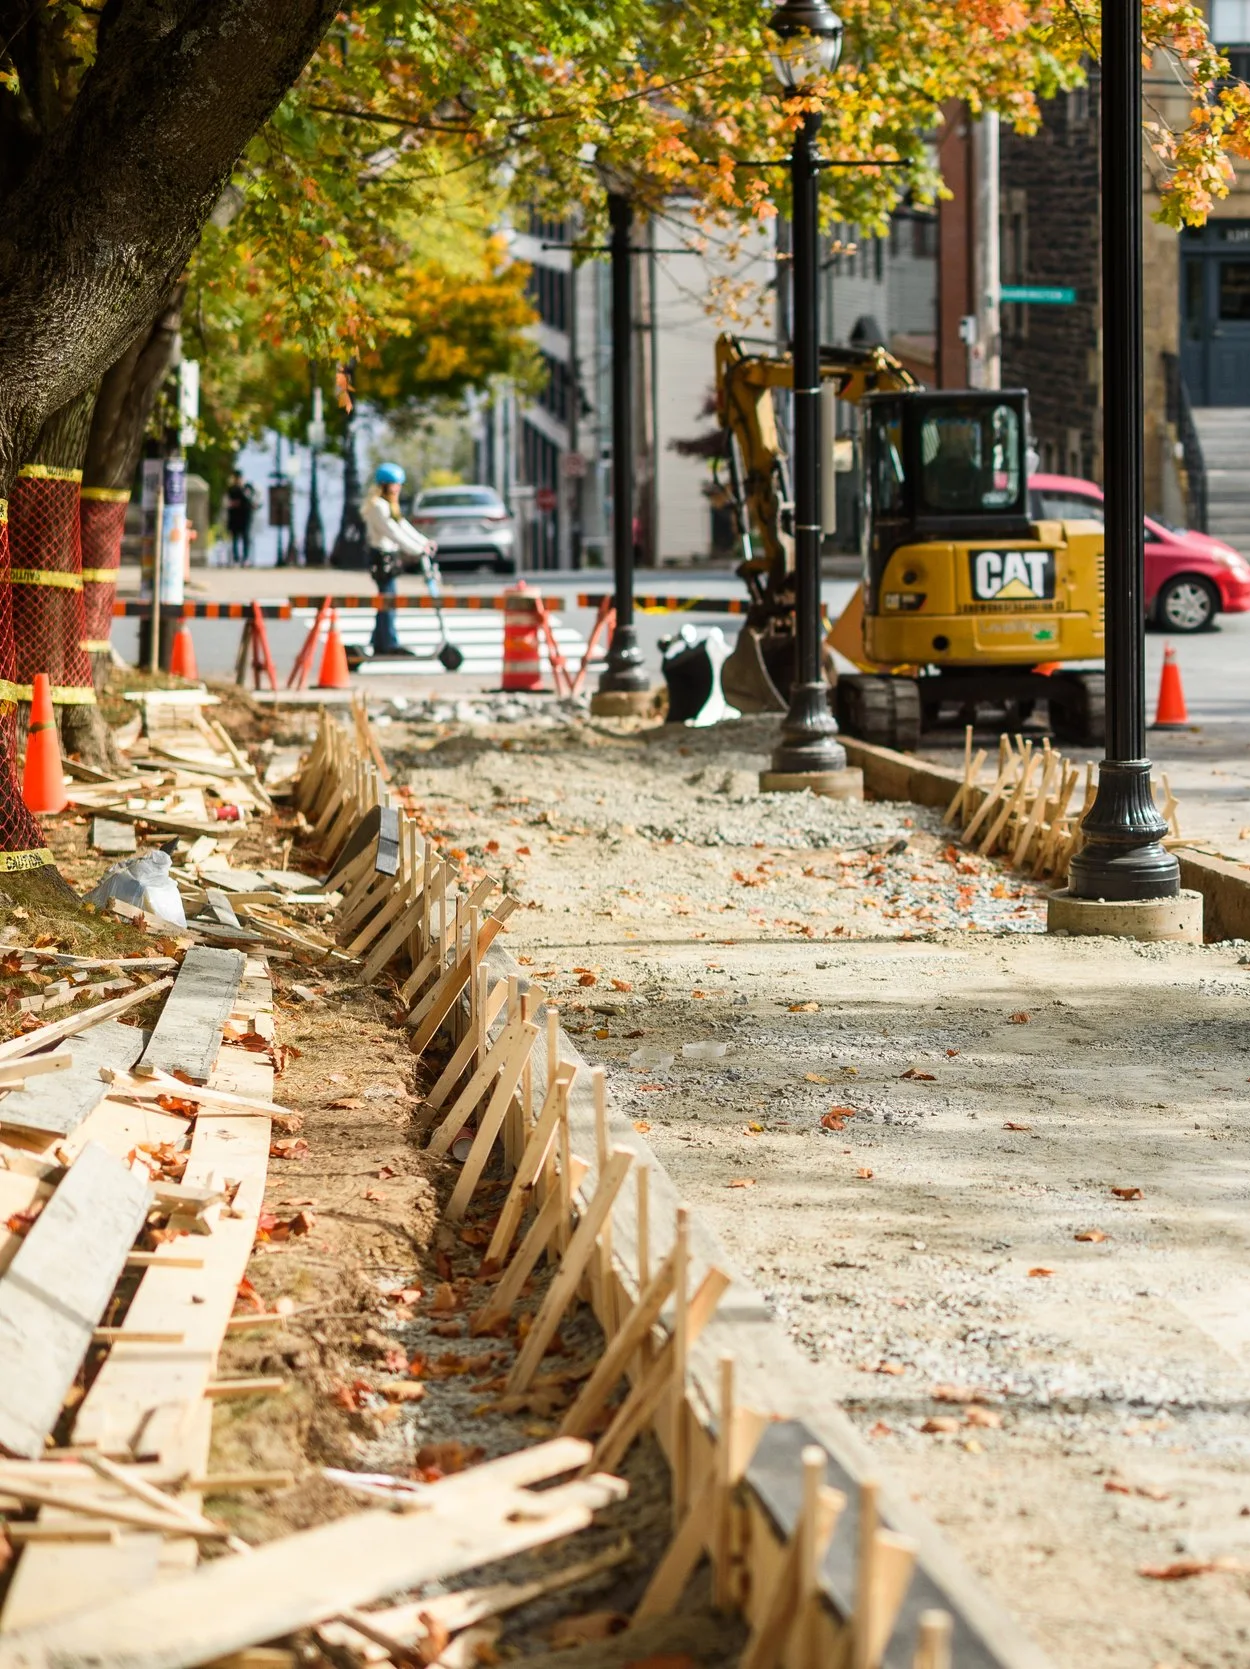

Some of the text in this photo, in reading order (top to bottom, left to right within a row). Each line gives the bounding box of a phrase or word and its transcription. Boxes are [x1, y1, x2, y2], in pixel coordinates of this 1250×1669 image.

[10, 571, 41, 581] CAUTIO
[975, 551, 1049, 599] CAT
[7, 852, 44, 870] CAUTION
